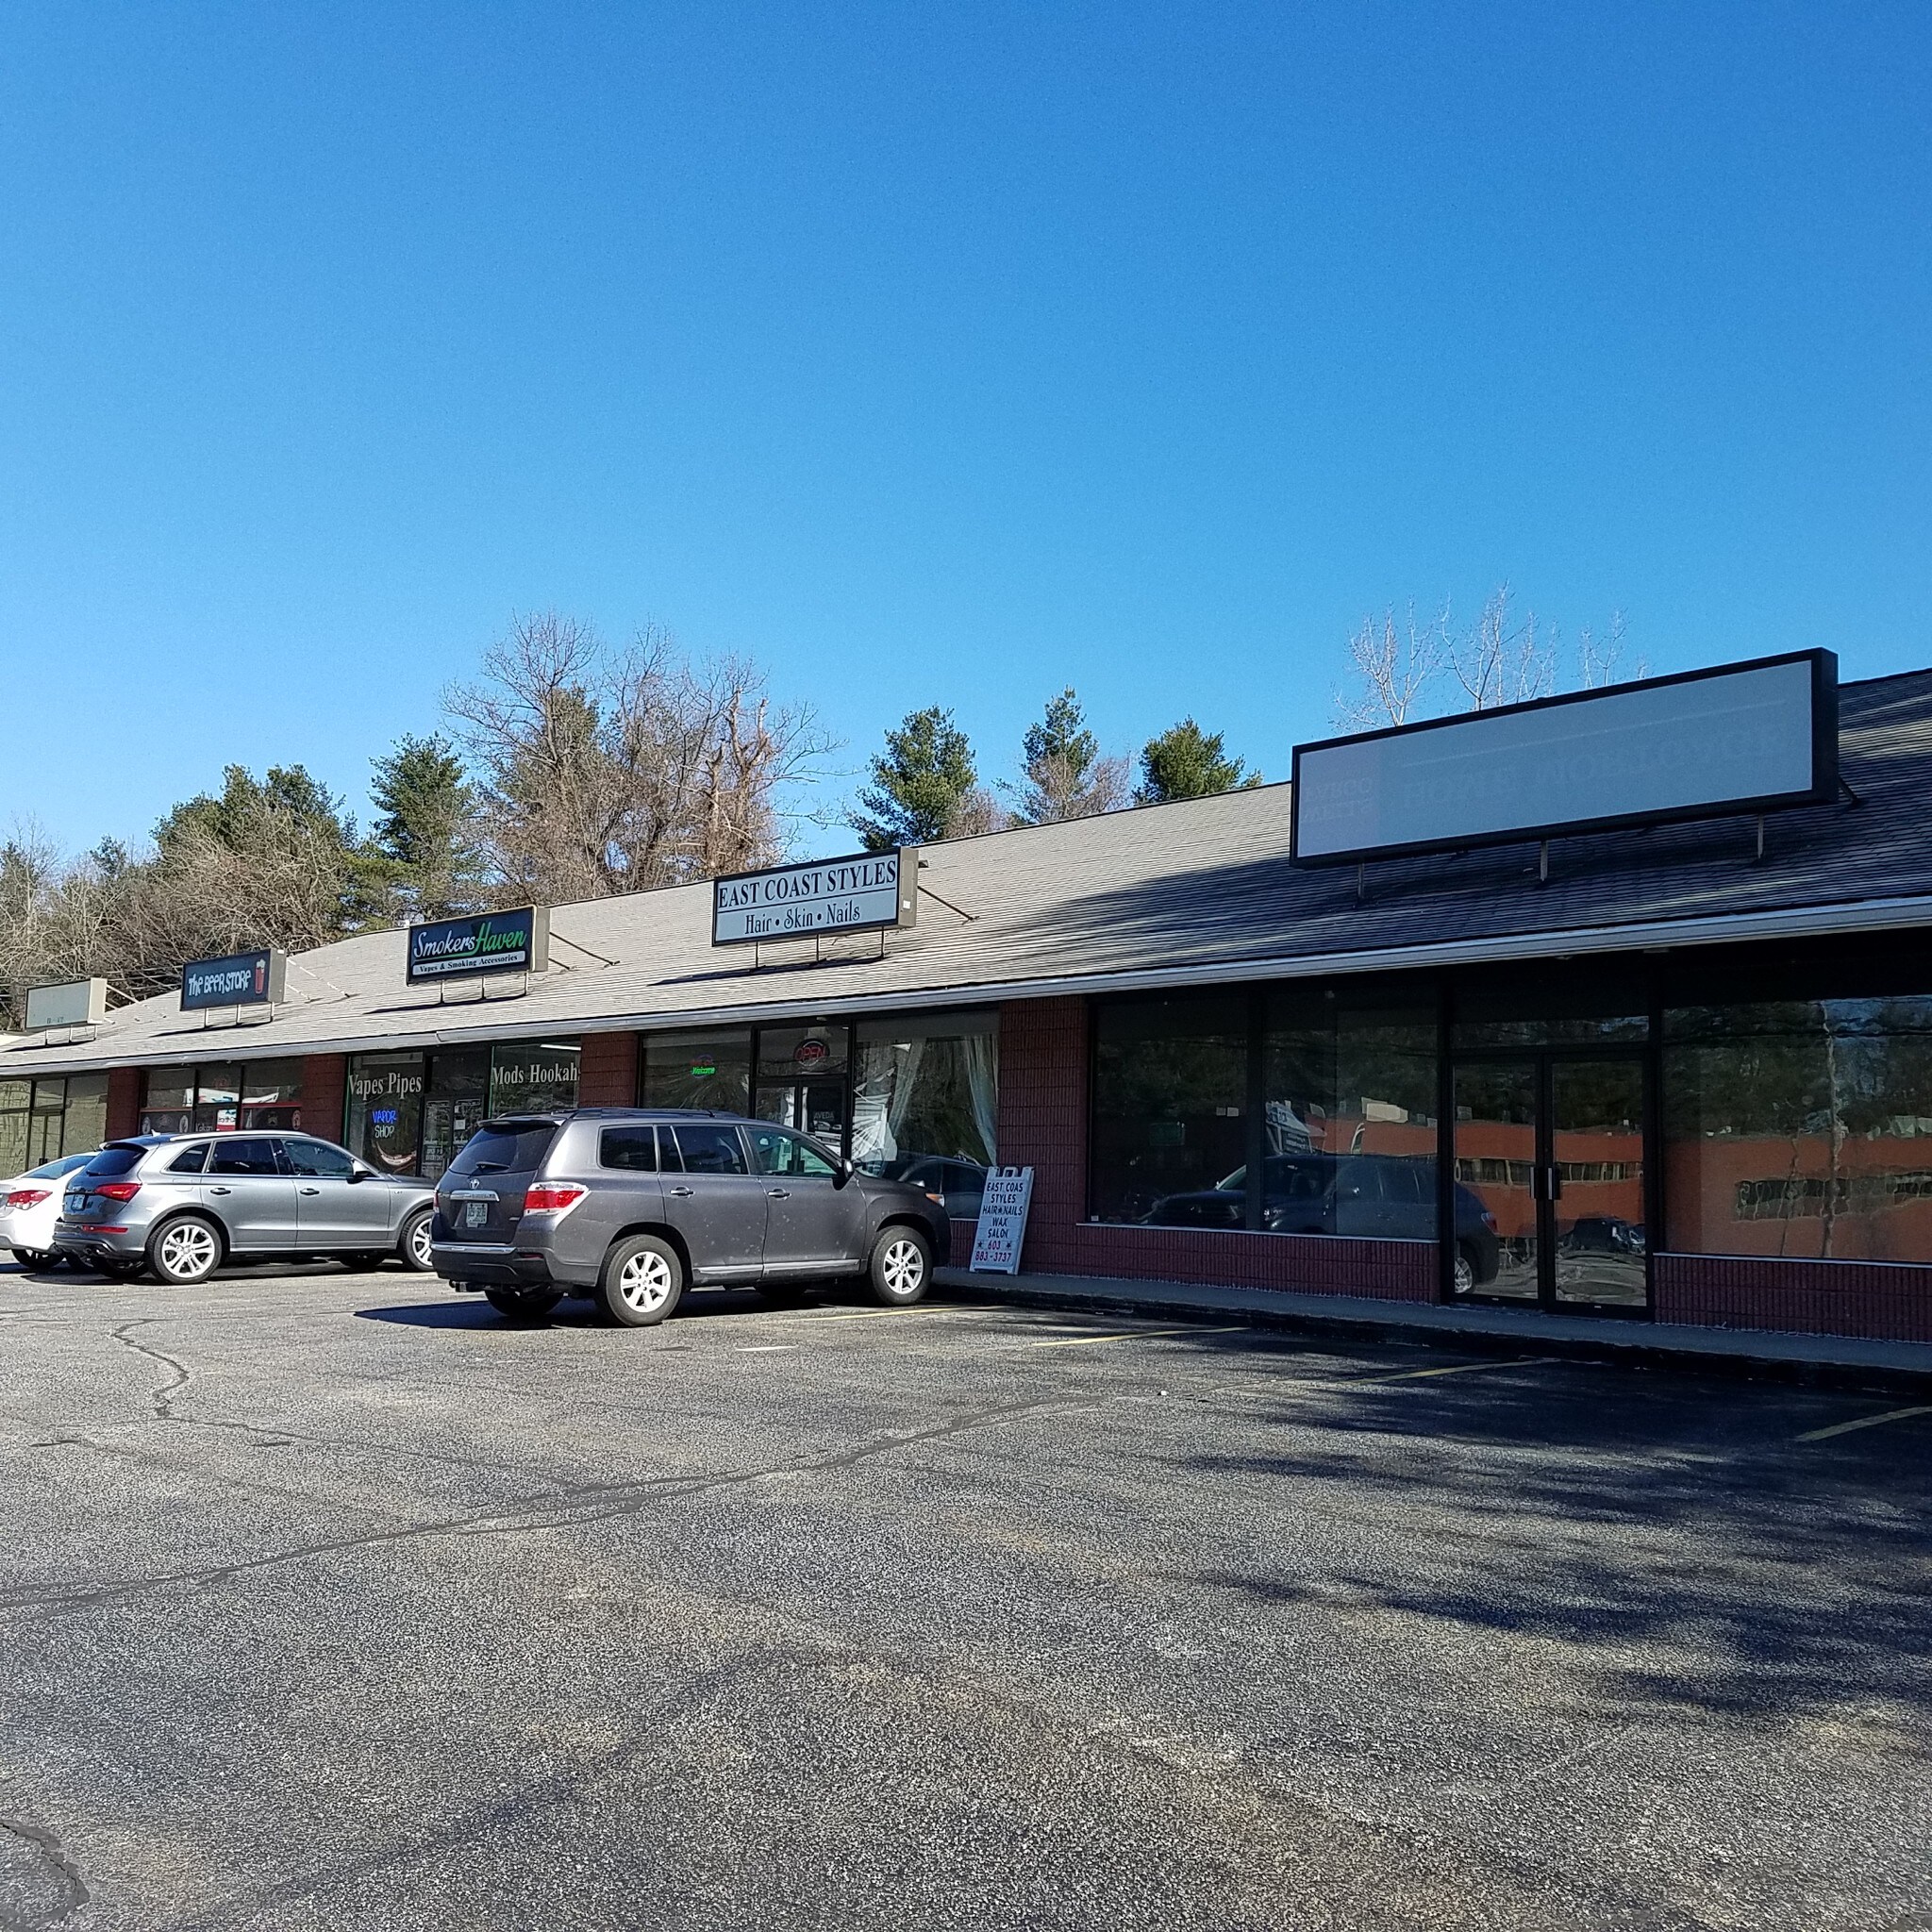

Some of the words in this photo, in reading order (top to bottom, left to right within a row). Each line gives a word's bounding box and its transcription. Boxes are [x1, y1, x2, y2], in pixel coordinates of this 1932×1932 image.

[718, 882, 760, 908] EAST
[765, 872, 823, 901] COAST
[826, 859, 896, 891] STYLES
[744, 914, 773, 935] Hair
[783, 907, 814, 930] Skin
[825, 899, 860, 925] Nails
[420, 965, 438, 974] Vapes
[448, 958, 477, 970] Smoking
[480, 954, 518, 966] Accessories
[794, 1045, 826, 1063] OPEN
[491, 1065, 525, 1085] Mods
[349, 1074, 384, 1101] Vapes
[388, 1073, 422, 1100] Pipes
[373, 1109, 398, 1124] VAPOR
[375, 1124, 394, 1139] SHOP
[987, 1182, 1004, 1192] EAST
[1006, 1182, 1024, 1192] COAS
[991, 1193, 1016, 1203] STYLES
[992, 1217, 1008, 1227] WAX
[988, 1228, 1008, 1239] SALON
[988, 1241, 1001, 1250] 603
